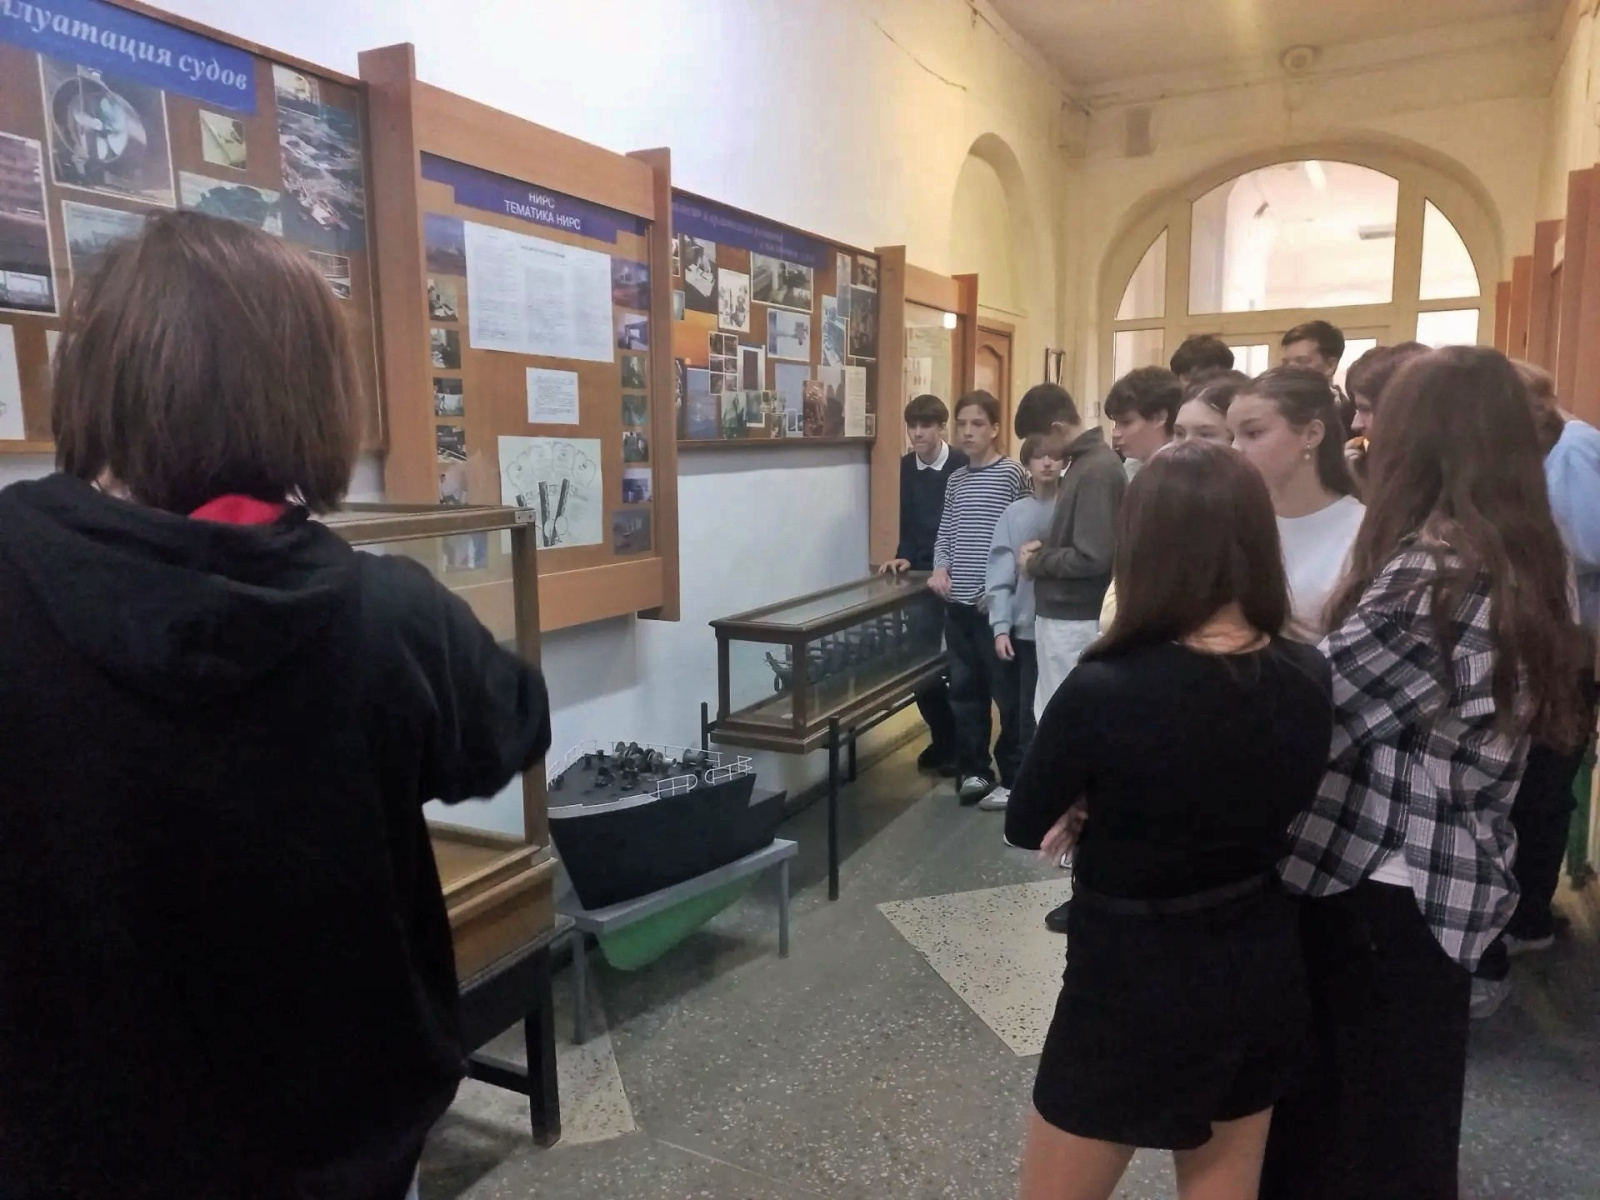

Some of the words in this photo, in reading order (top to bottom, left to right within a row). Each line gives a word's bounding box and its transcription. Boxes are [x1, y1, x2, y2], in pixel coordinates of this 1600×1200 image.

[178, 54, 248, 91] судов
[504, 199, 555, 224] ТЕМАТИКА
[556, 213, 581, 231] НИРС
[528, 192, 555, 209] НИРС
